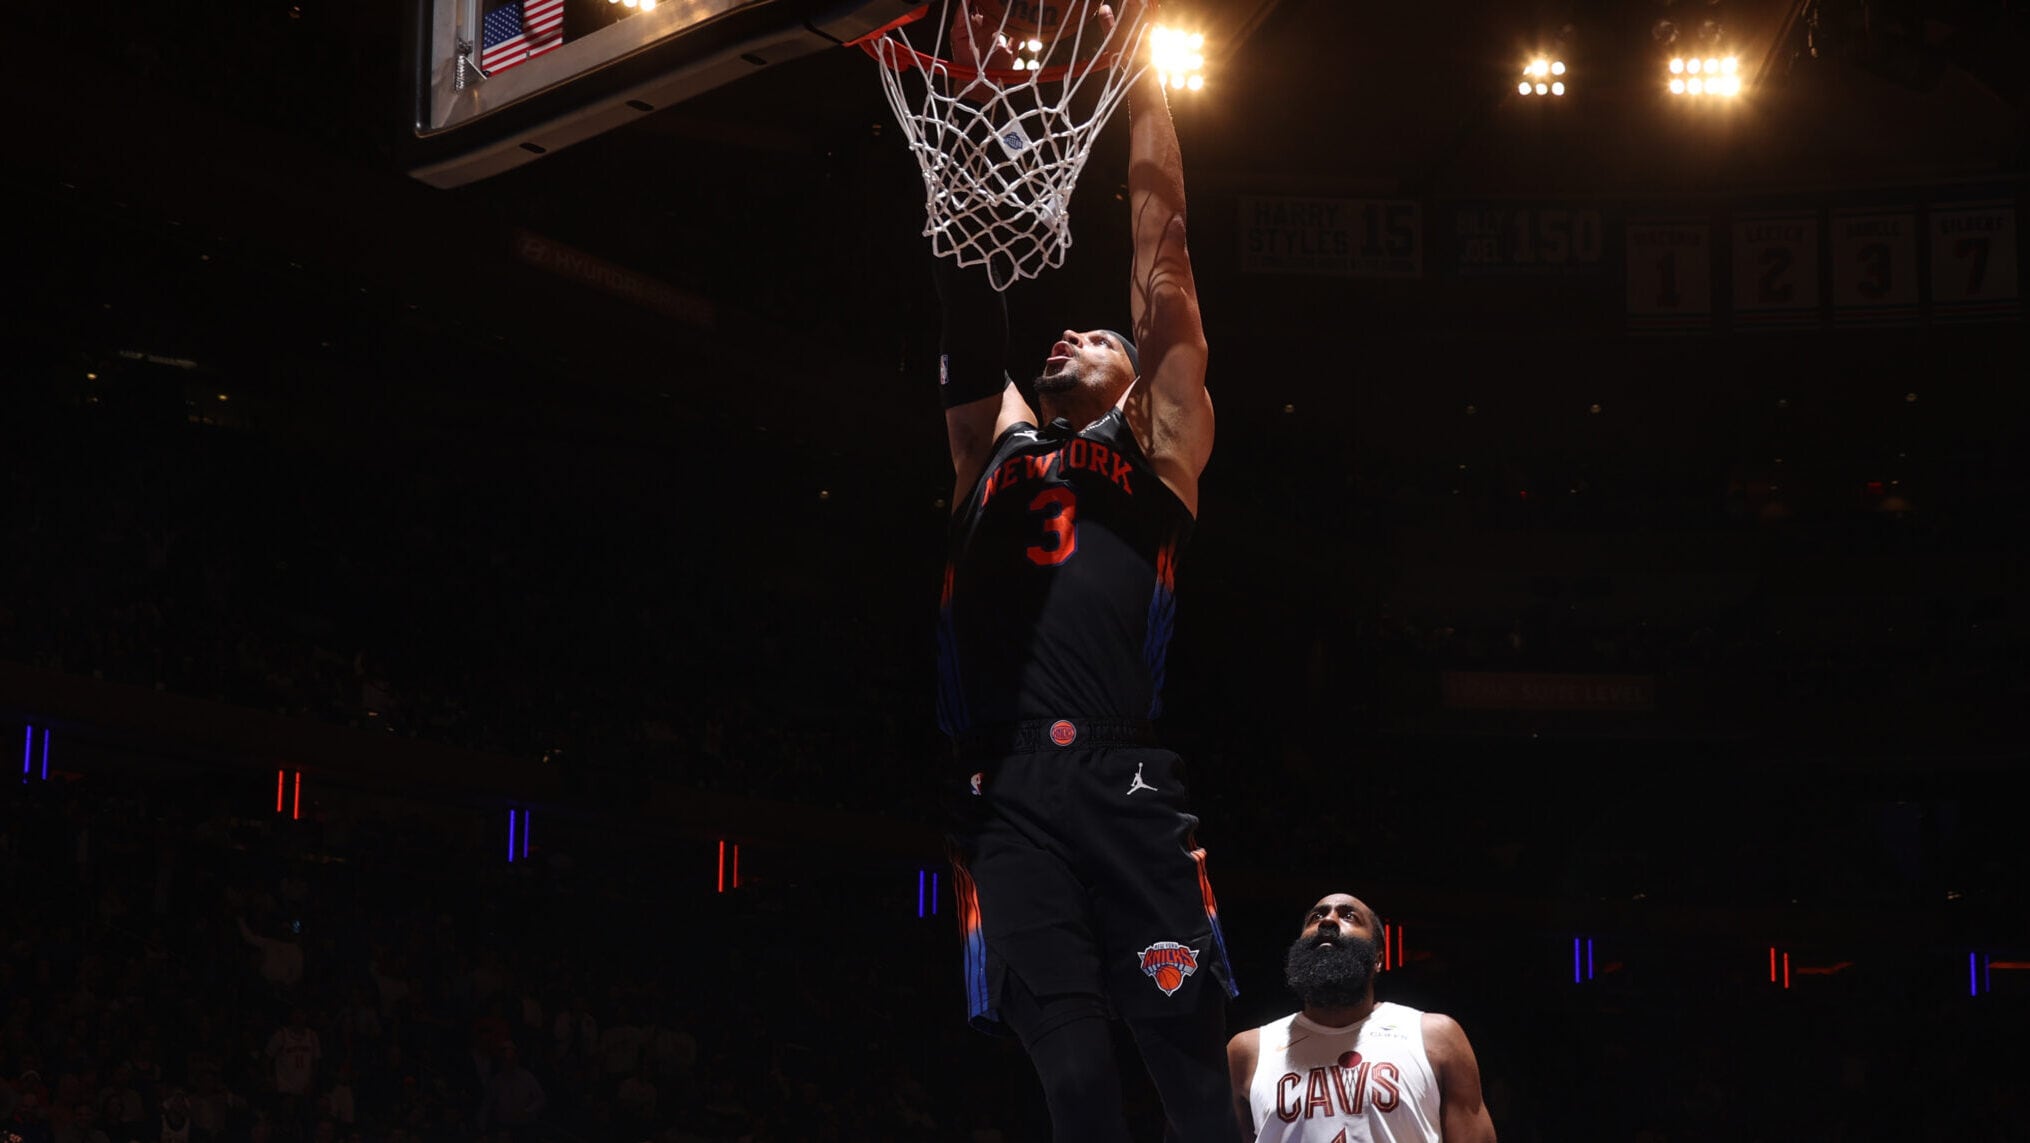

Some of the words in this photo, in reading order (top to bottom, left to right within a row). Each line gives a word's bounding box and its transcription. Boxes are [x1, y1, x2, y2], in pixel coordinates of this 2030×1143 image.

[1248, 227, 1349, 255] STYLES
[1254, 201, 1339, 227] HARRY
[1360, 204, 1414, 256] 15
[1512, 207, 1602, 263] 150
[1656, 250, 1681, 308] 1
[1757, 247, 1794, 304] 2
[1856, 242, 1891, 299] 3
[1953, 236, 1990, 296] 7
[981, 449, 1057, 509] NEW
[1026, 484, 1078, 567] 3
[1143, 947, 1196, 969] KNICKS
[1277, 1061, 1400, 1124] CAVS
